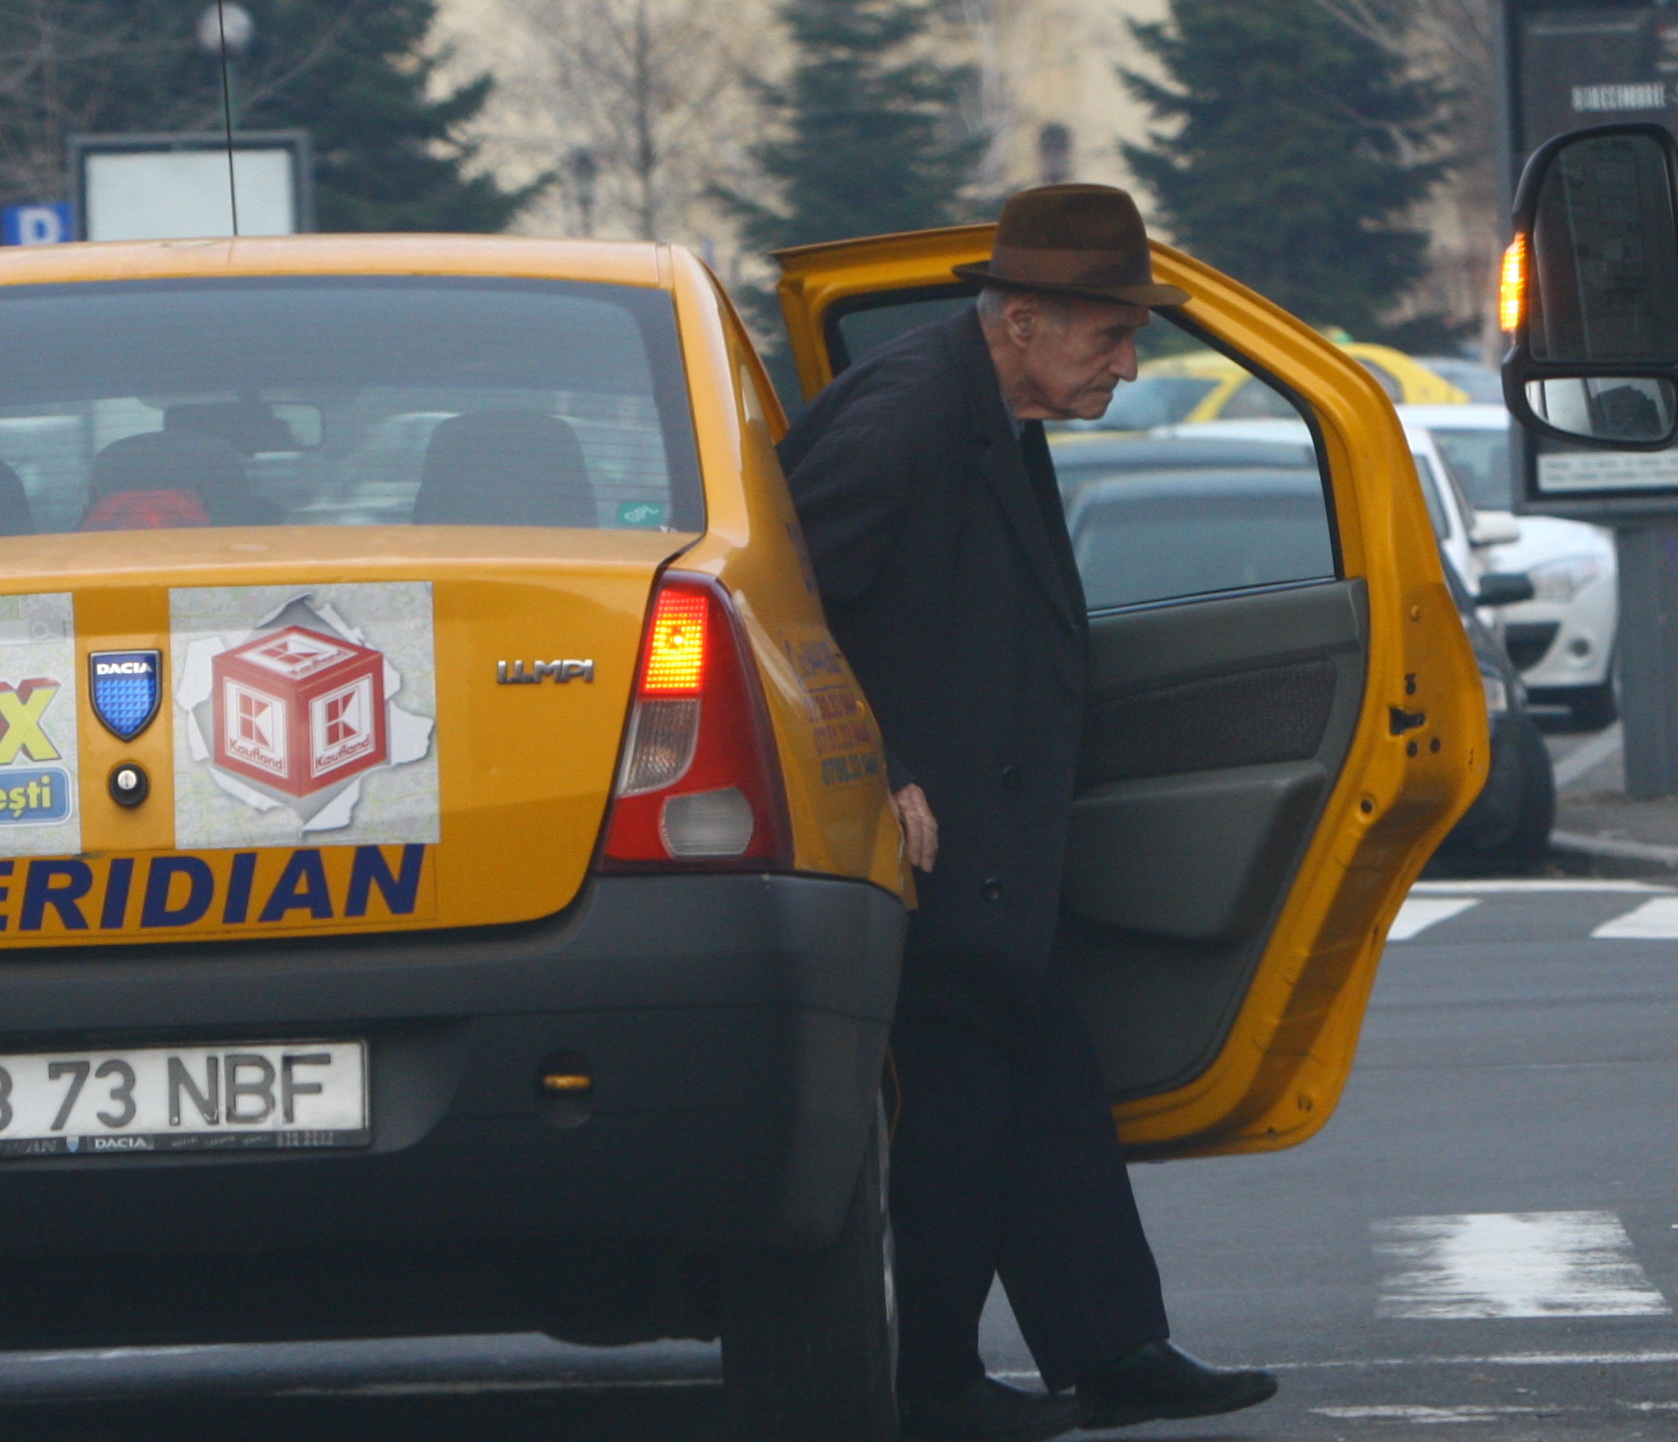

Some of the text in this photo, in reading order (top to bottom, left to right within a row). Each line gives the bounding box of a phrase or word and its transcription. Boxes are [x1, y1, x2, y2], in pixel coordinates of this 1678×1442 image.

[96, 662, 153, 675] DACIA
[229, 739, 283, 771] Kaufland
[315, 736, 370, 770] Kaufland
[0, 843, 427, 931] RIDIAN
[48, 1060, 137, 1132] 73
[167, 1053, 332, 1126] NBF
[94, 1137, 147, 1150] DACIA
